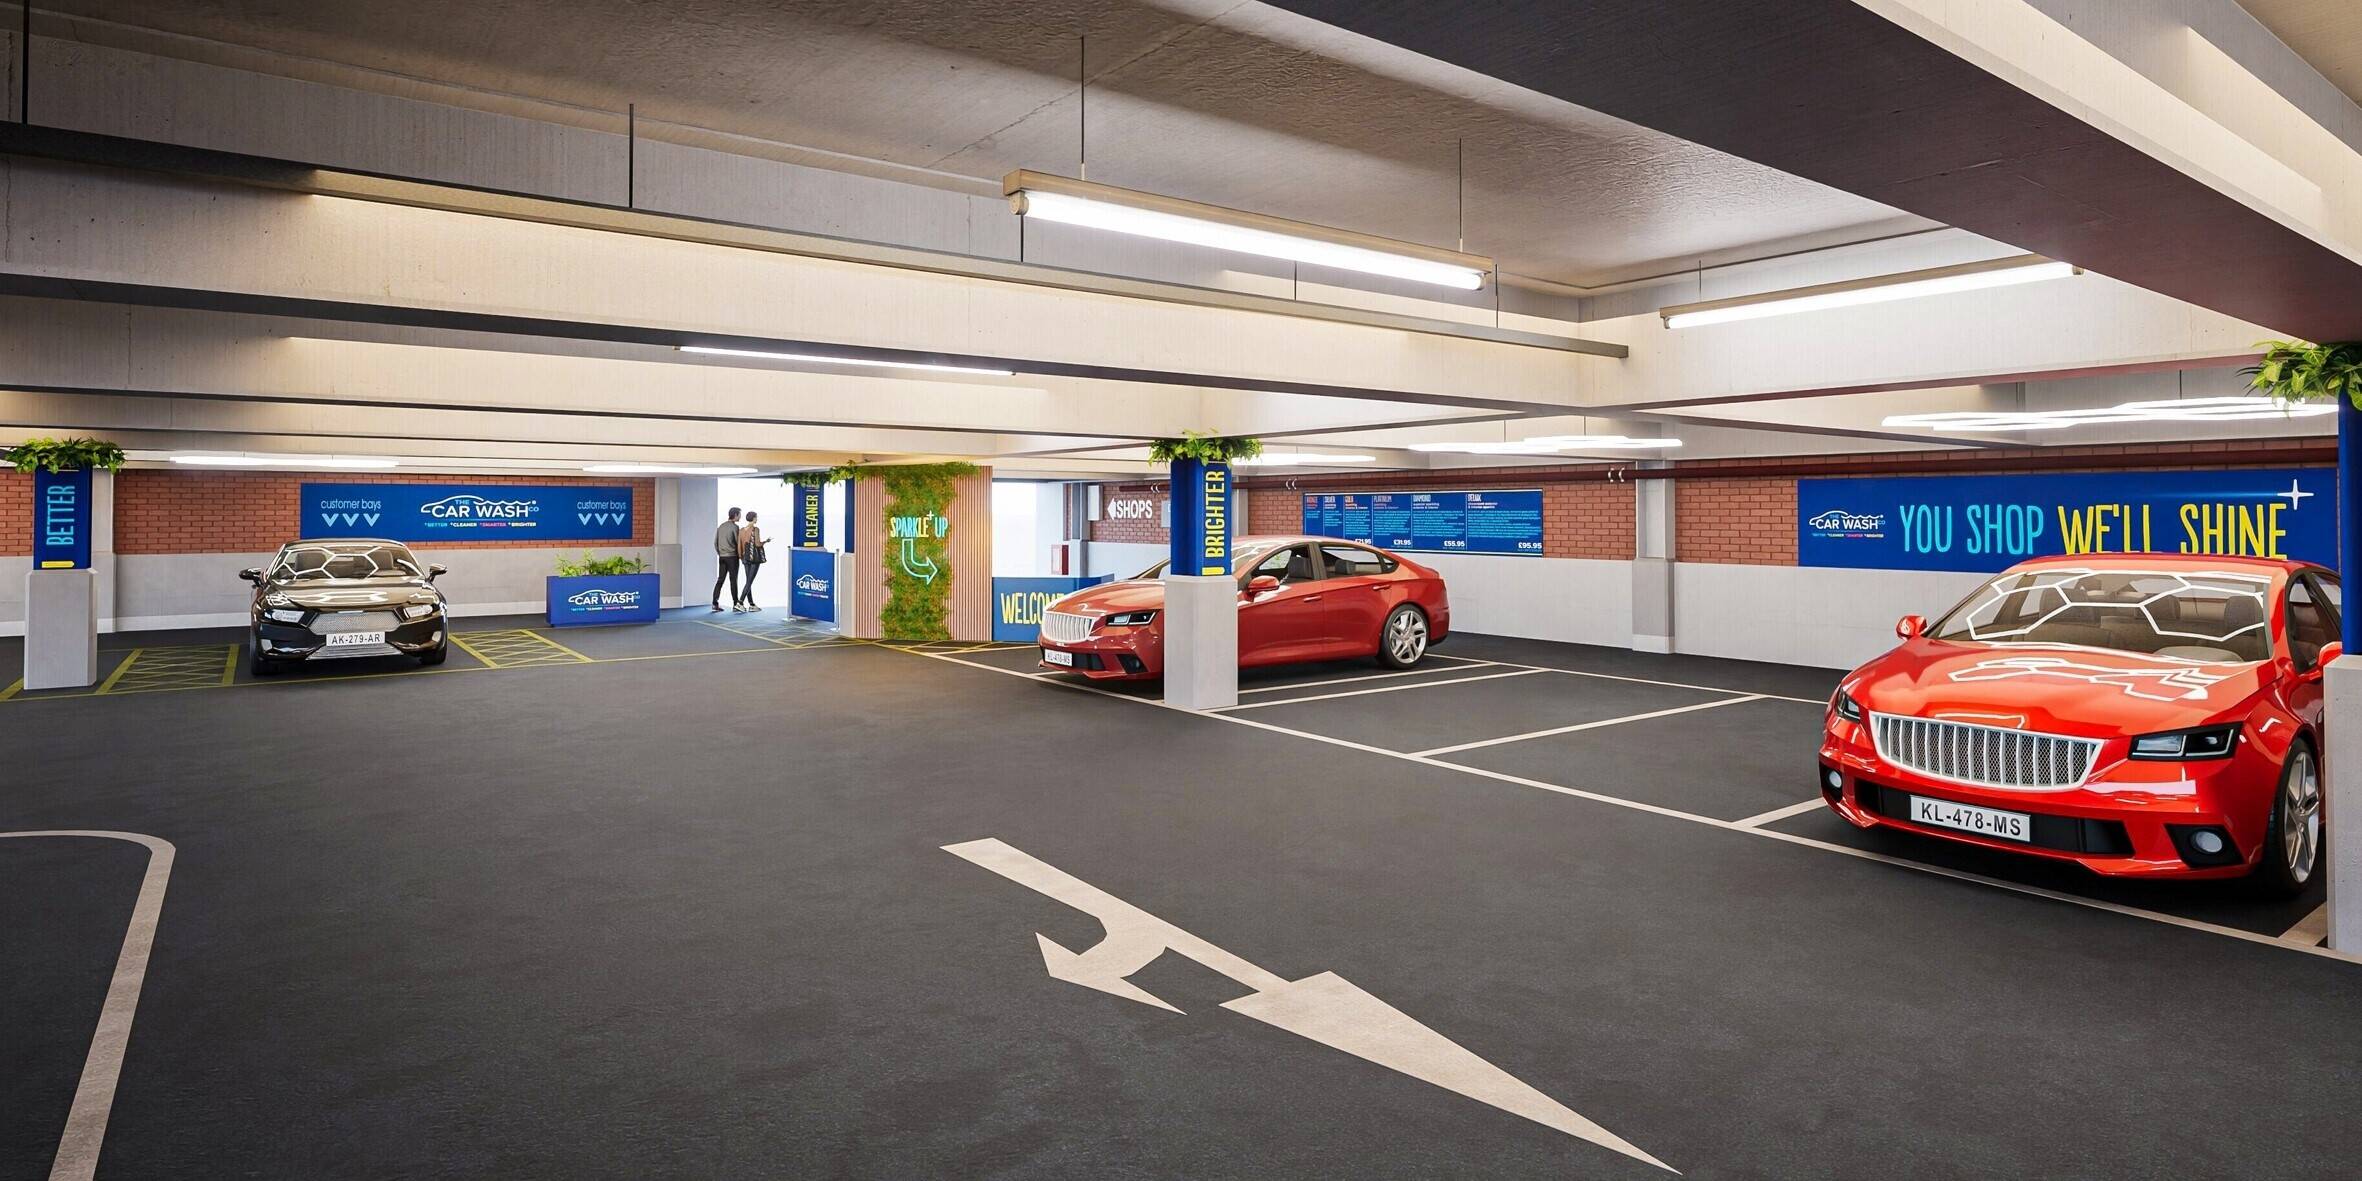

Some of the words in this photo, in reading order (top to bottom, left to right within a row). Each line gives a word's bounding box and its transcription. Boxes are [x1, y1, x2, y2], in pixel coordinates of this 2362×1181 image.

[320, 498, 360, 510] customer
[361, 498, 382, 512] bays
[432, 505, 470, 518] CAR
[475, 505, 529, 518] WASH
[576, 500, 609, 510] customer
[609, 500, 627, 511] bays
[1116, 499, 1153, 519] SHOPS
[1205, 471, 1225, 558] BRIGHTER
[46, 485, 75, 546] BETTER
[806, 495, 818, 537] CLEANER
[1815, 519, 1840, 530] CAR
[1842, 519, 1879, 530] WASH
[890, 516, 930, 538] SPARKLE
[934, 516, 949, 538] UP
[1900, 504, 1953, 554] YOU
[1966, 504, 2044, 555] SHOP
[2057, 504, 2152, 556] WE'LL
[2180, 503, 2289, 560] SHINE
[799, 581, 810, 590] CAR
[811, 581, 827, 592] WASH
[574, 596, 599, 605] CAR
[601, 595, 634, 605] WASH
[1000, 591, 1065, 625] WELCO
[331, 633, 381, 645] AK-279-AR
[1921, 802, 2021, 836] KL-478-MS
